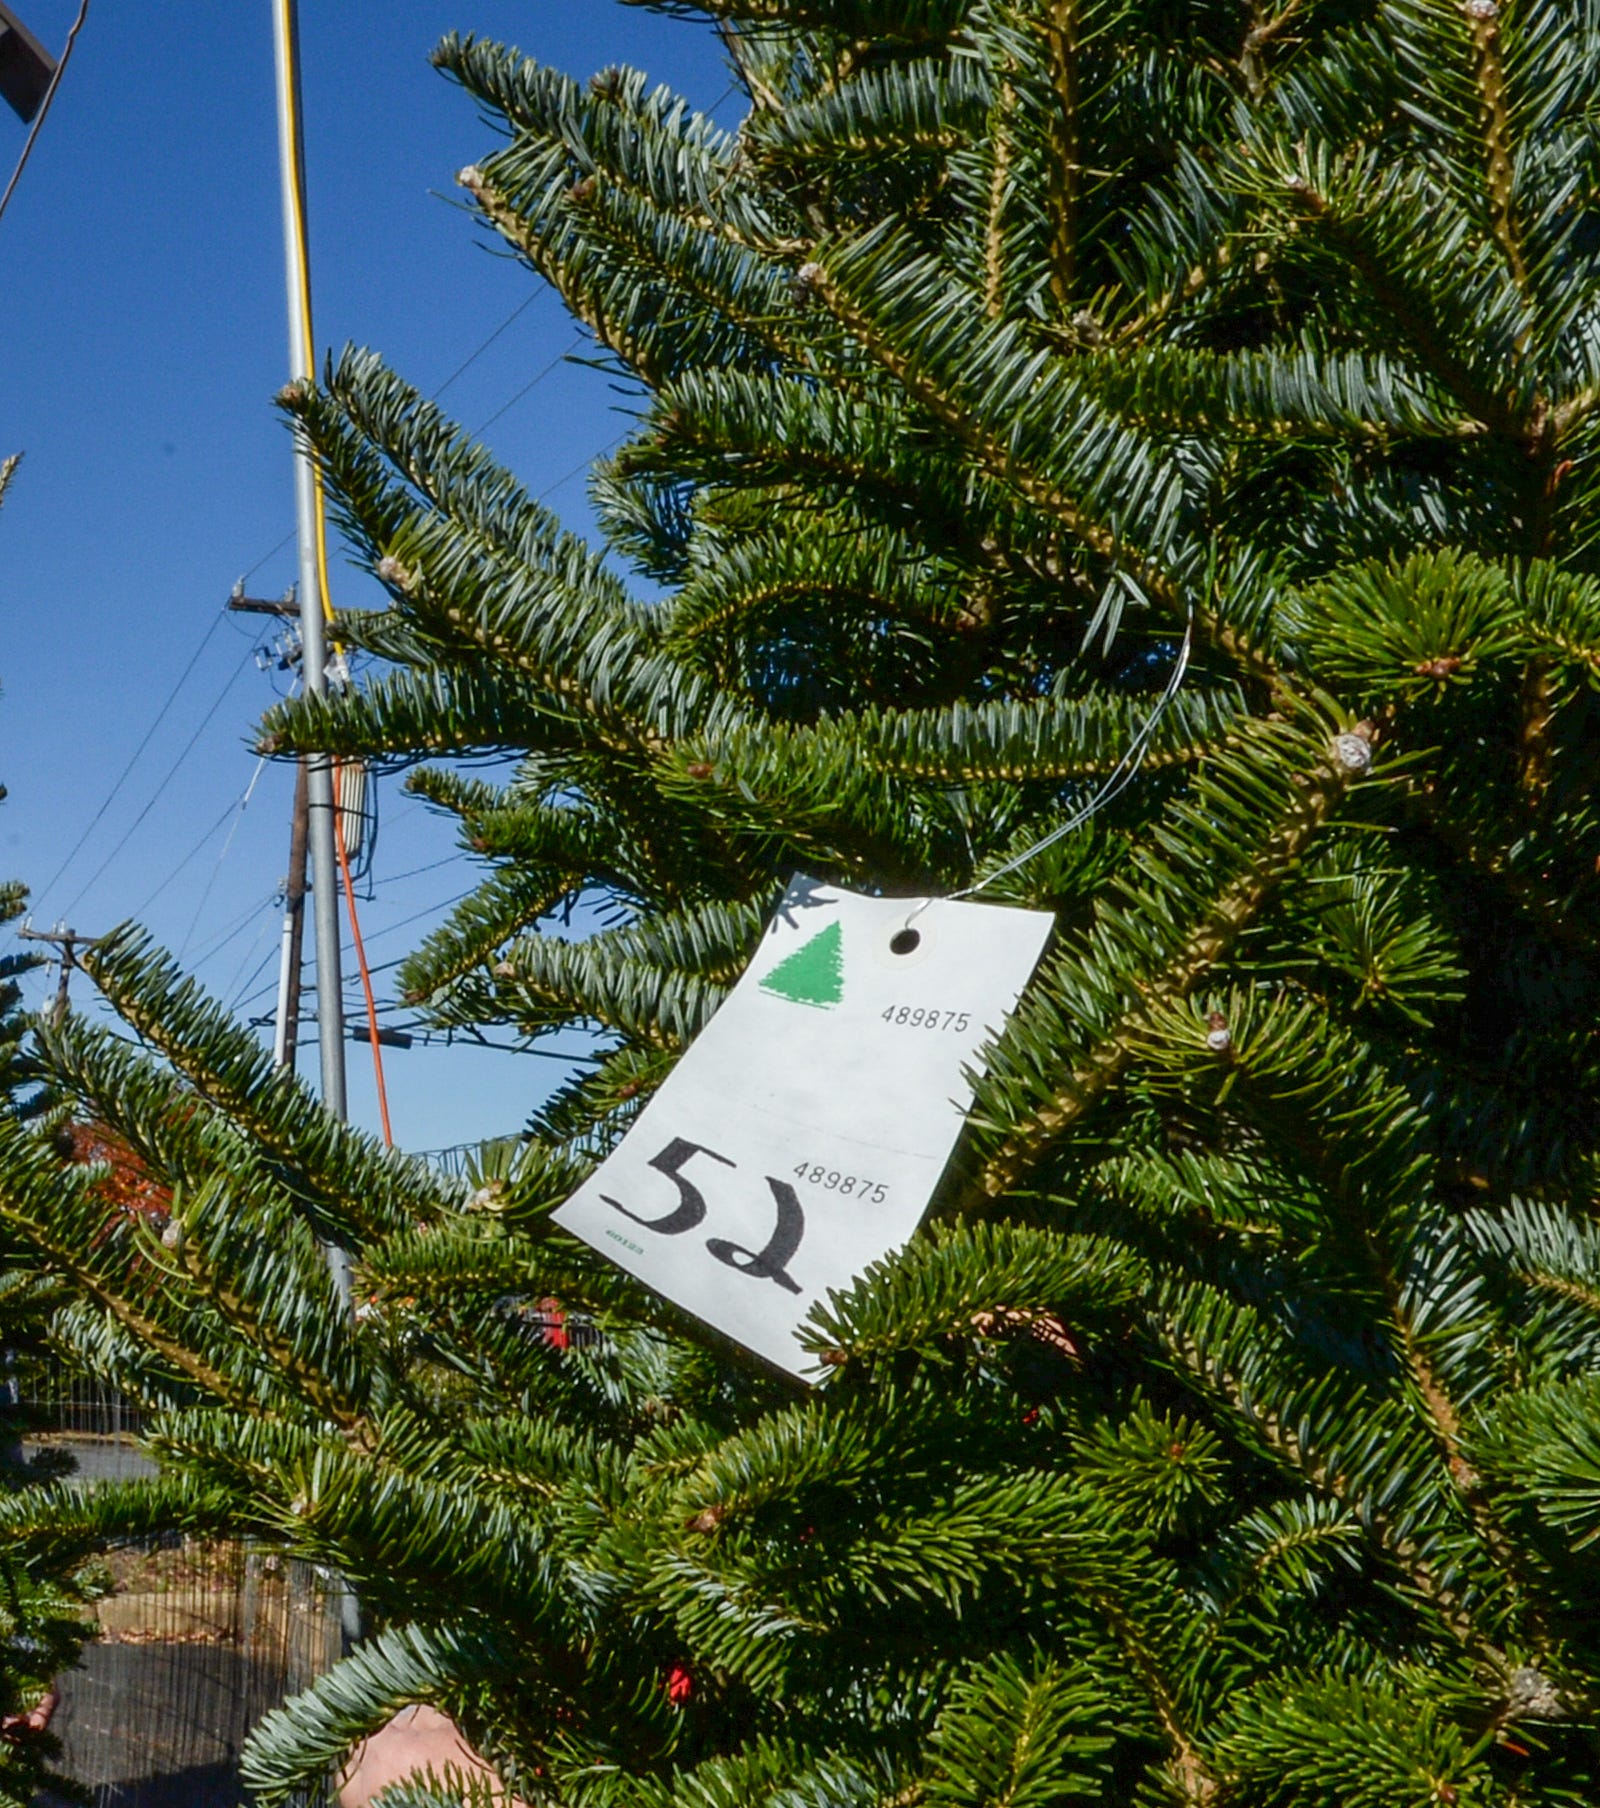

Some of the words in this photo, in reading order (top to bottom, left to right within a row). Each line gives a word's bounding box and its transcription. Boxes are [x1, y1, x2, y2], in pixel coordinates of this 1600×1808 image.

[880, 1004, 972, 1034] 489875
[792, 1160, 890, 1205] 489875
[599, 1136, 805, 1296] 52
